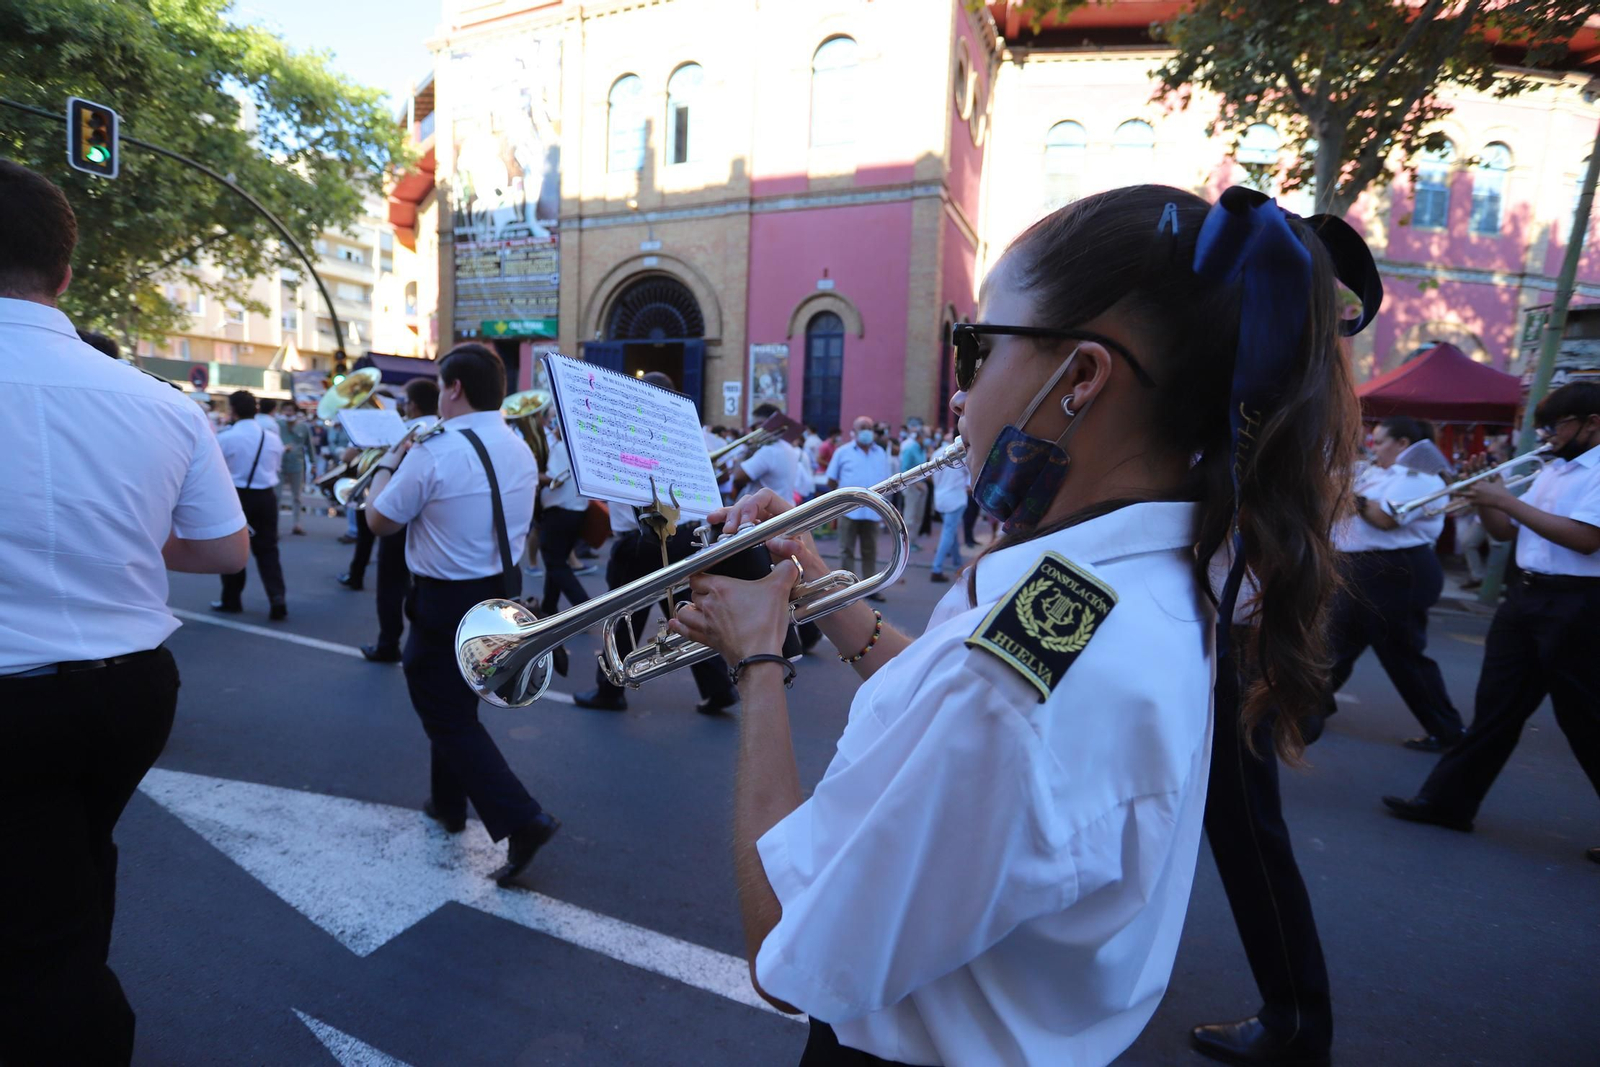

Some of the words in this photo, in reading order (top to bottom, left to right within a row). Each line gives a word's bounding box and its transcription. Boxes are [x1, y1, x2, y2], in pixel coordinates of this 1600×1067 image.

[726, 397, 736, 414] 3
[1040, 563, 1111, 615] CONSOLACIÓN
[990, 630, 1053, 686] HUELVA
